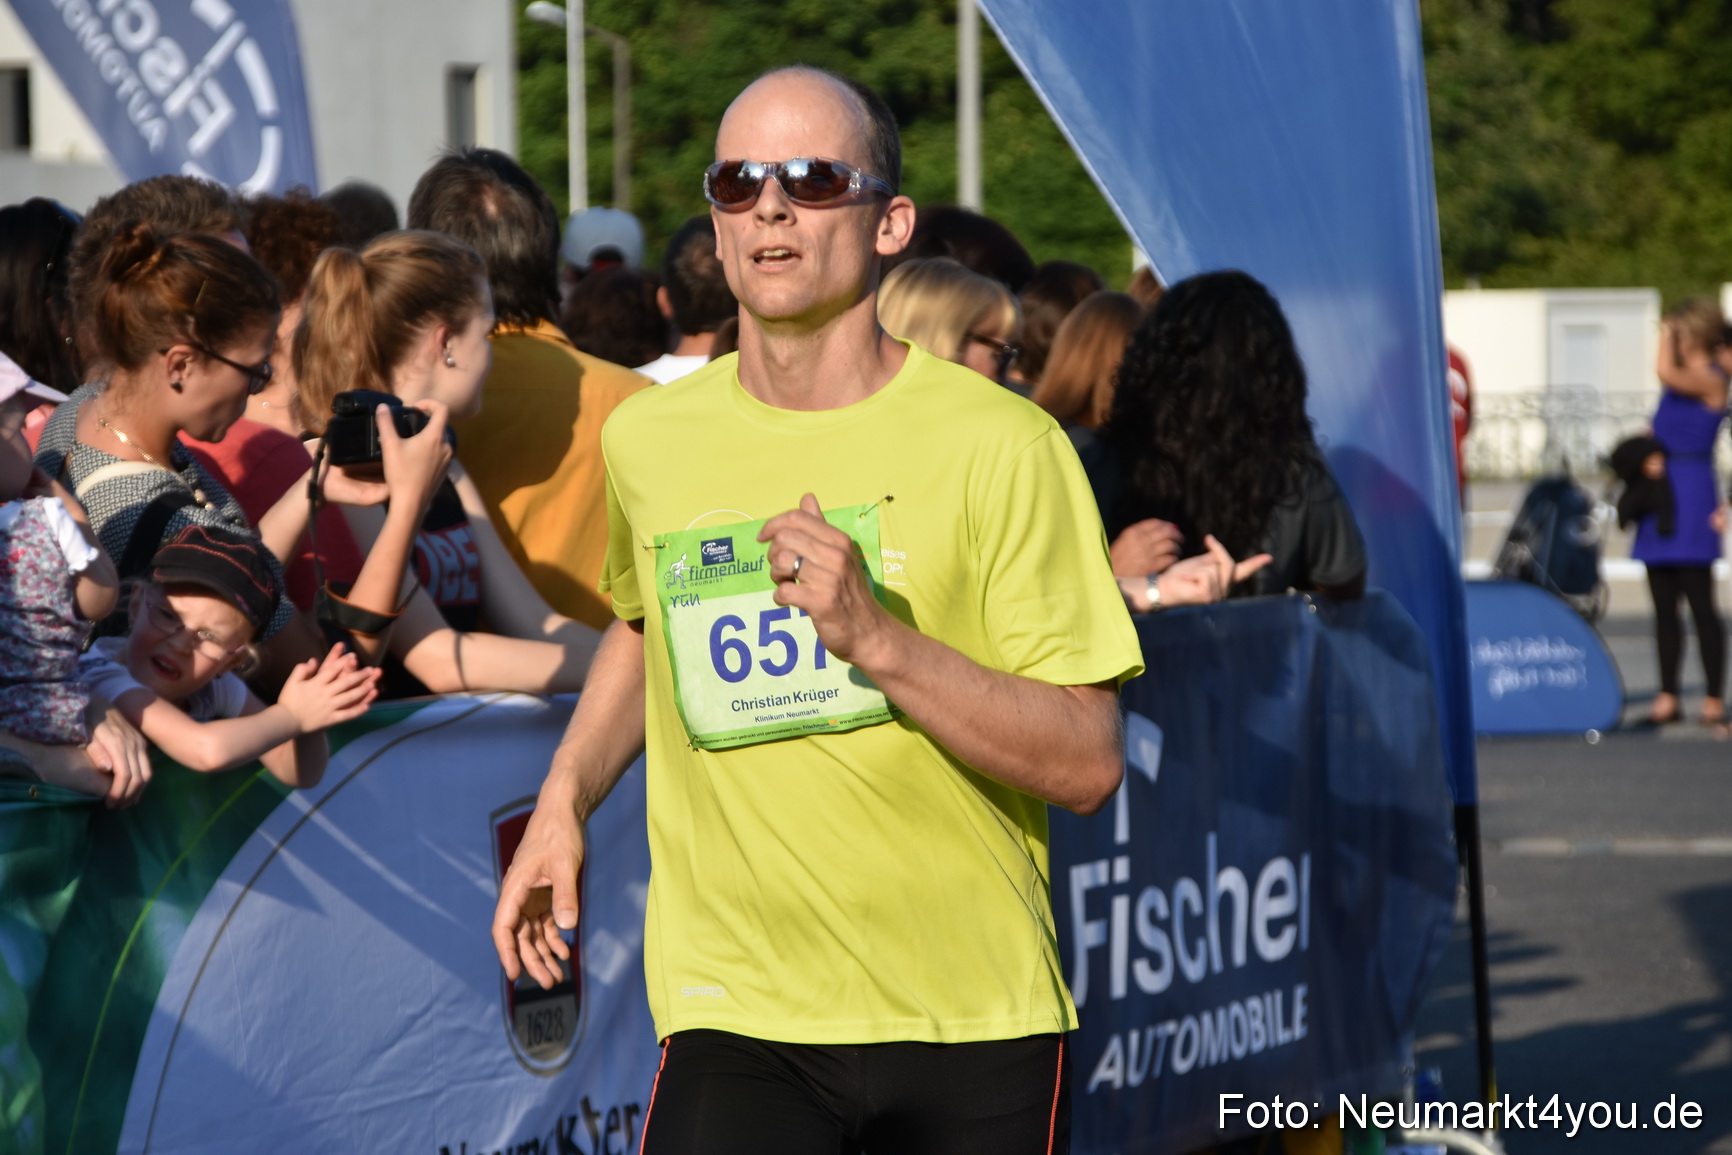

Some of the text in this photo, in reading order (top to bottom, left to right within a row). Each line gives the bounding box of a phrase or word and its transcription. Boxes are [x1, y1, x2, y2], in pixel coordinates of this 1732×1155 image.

[690, 555, 765, 580] firmenlauf
[690, 578, 723, 587] neumarkt
[731, 688, 840, 712] Christian Krüger
[755, 708, 820, 723] Klinikum Neumarkt
[681, 986, 726, 998] SPIRO
[526, 1005, 564, 1048] 1628
[1087, 983, 1308, 1094] AUTOMOBILE
